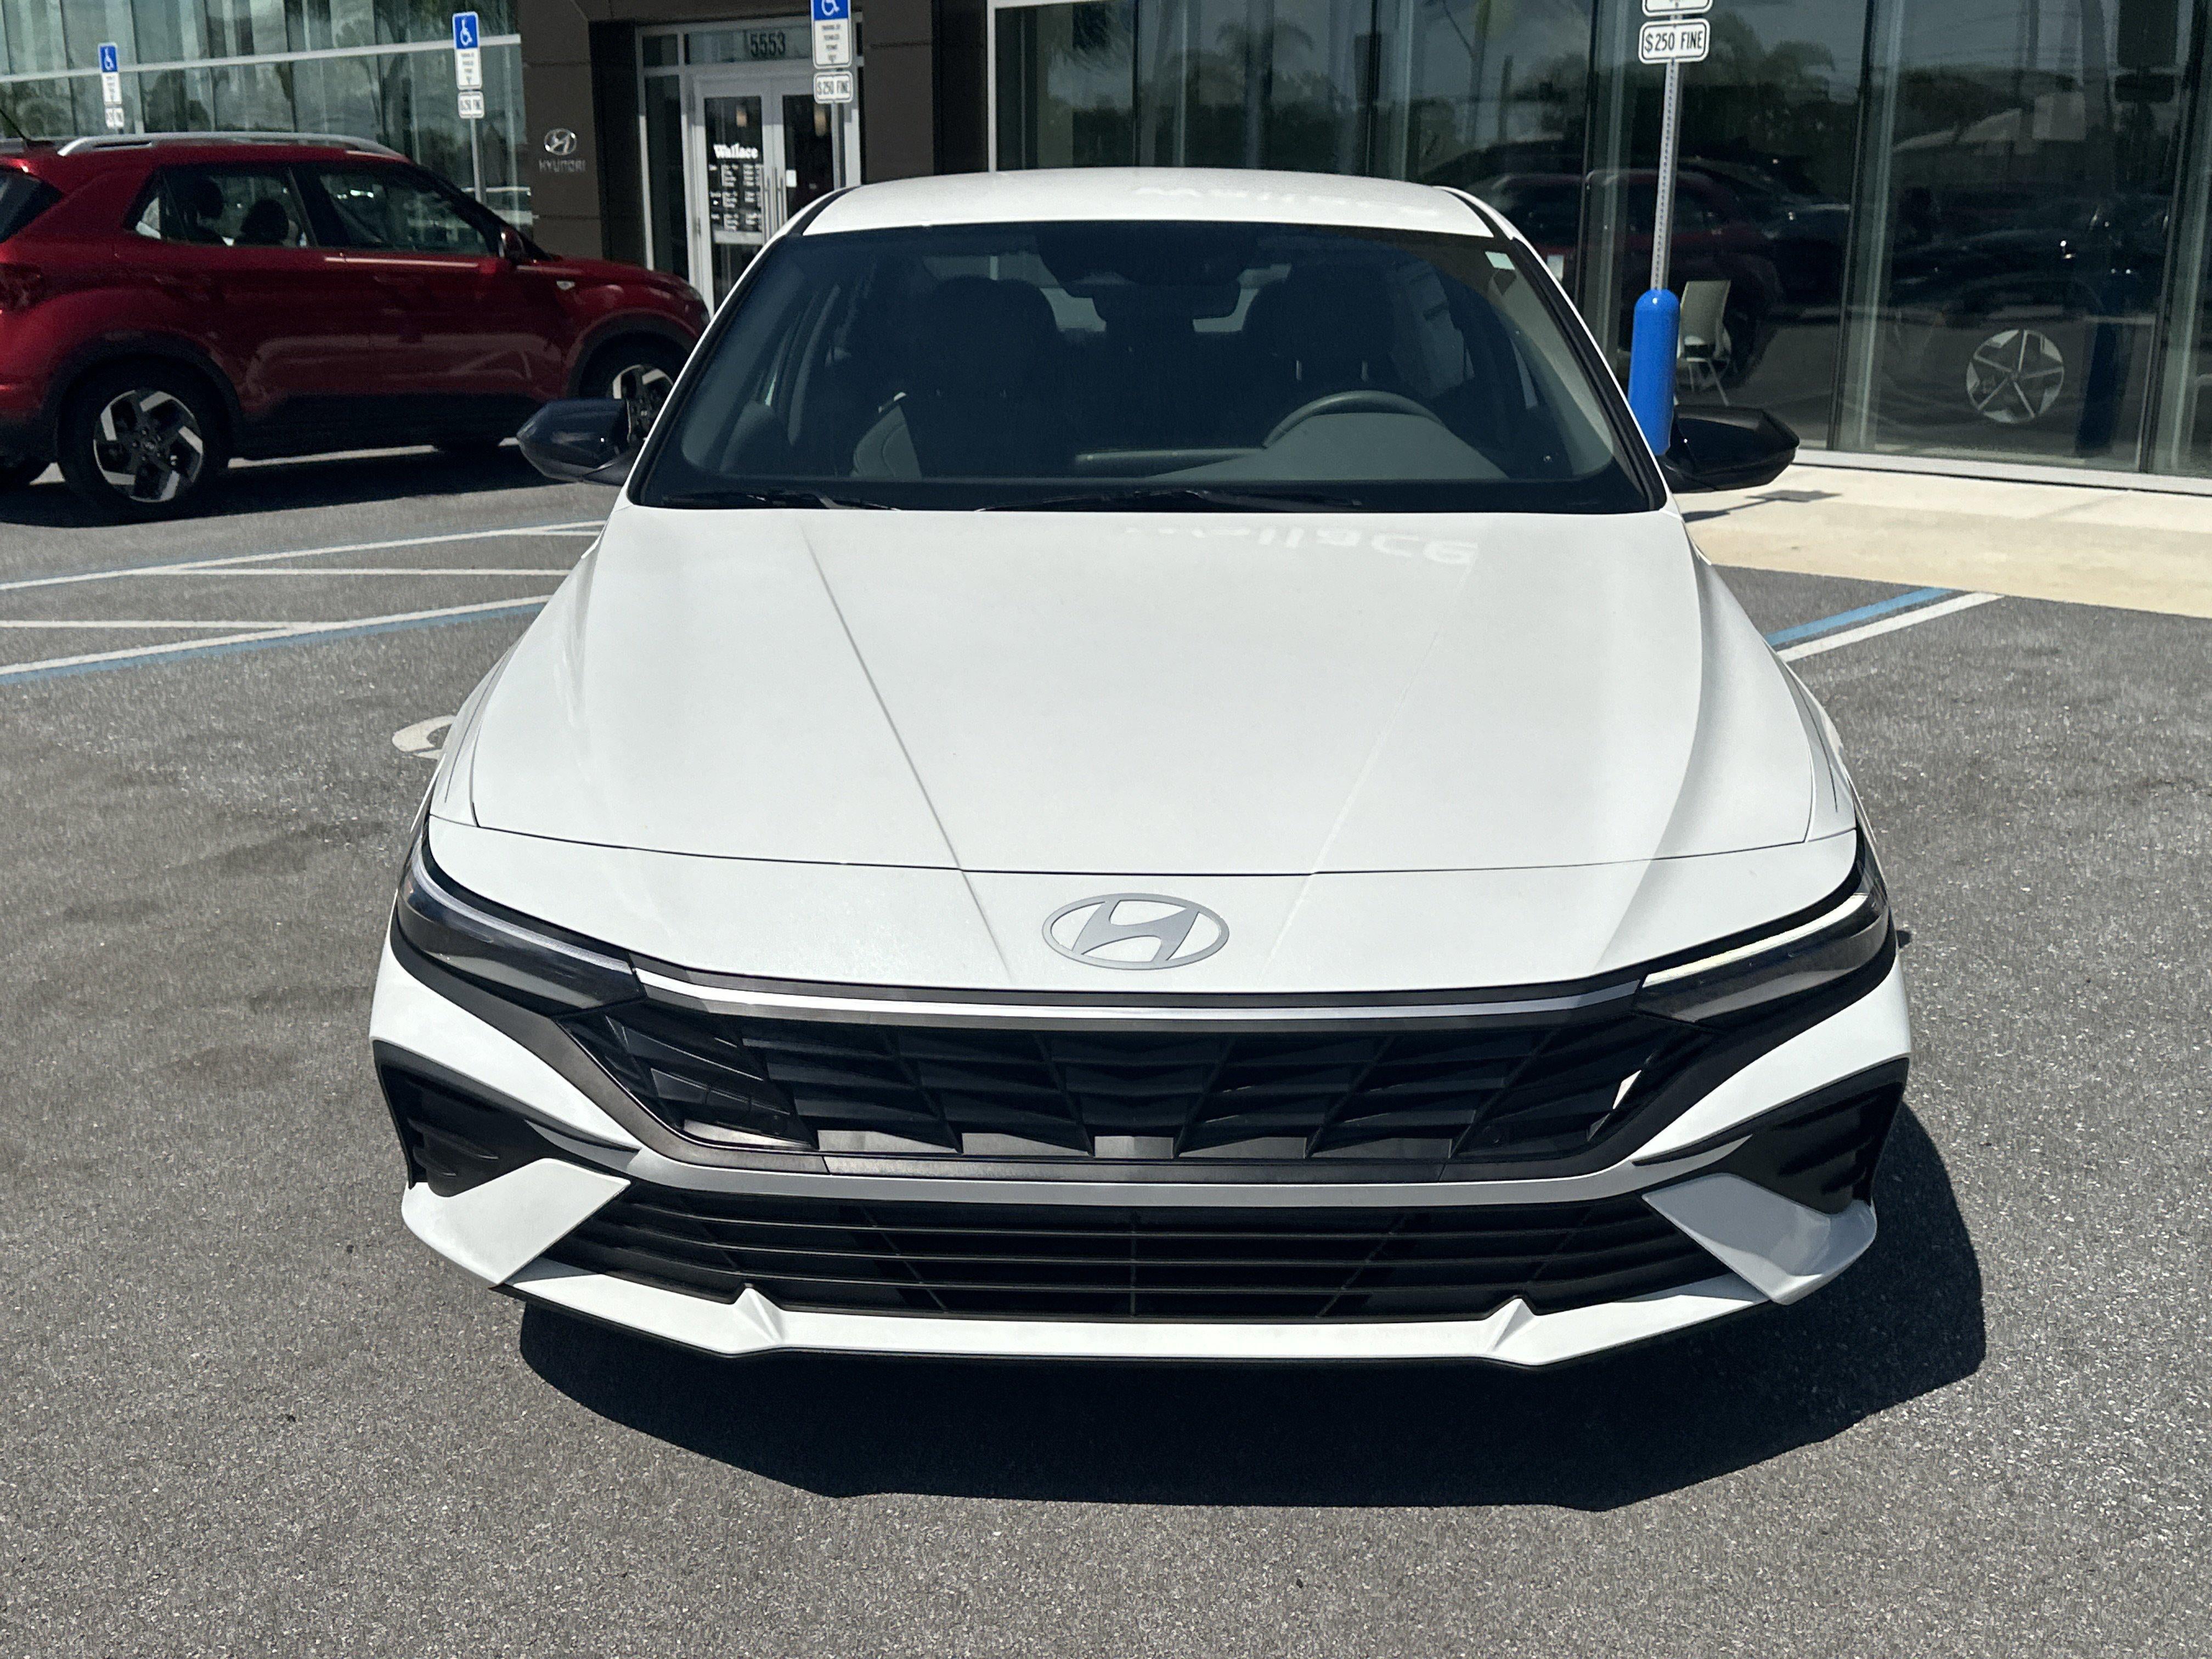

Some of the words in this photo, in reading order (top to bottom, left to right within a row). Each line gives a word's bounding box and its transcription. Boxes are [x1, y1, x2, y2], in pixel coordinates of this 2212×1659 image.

[750, 32, 786, 57] 5553
[1645, 32, 1675, 53] $250
[1681, 30, 1703, 50] FINE
[714, 143, 758, 159] Wallace
[539, 159, 585, 173] HYUNDAI
